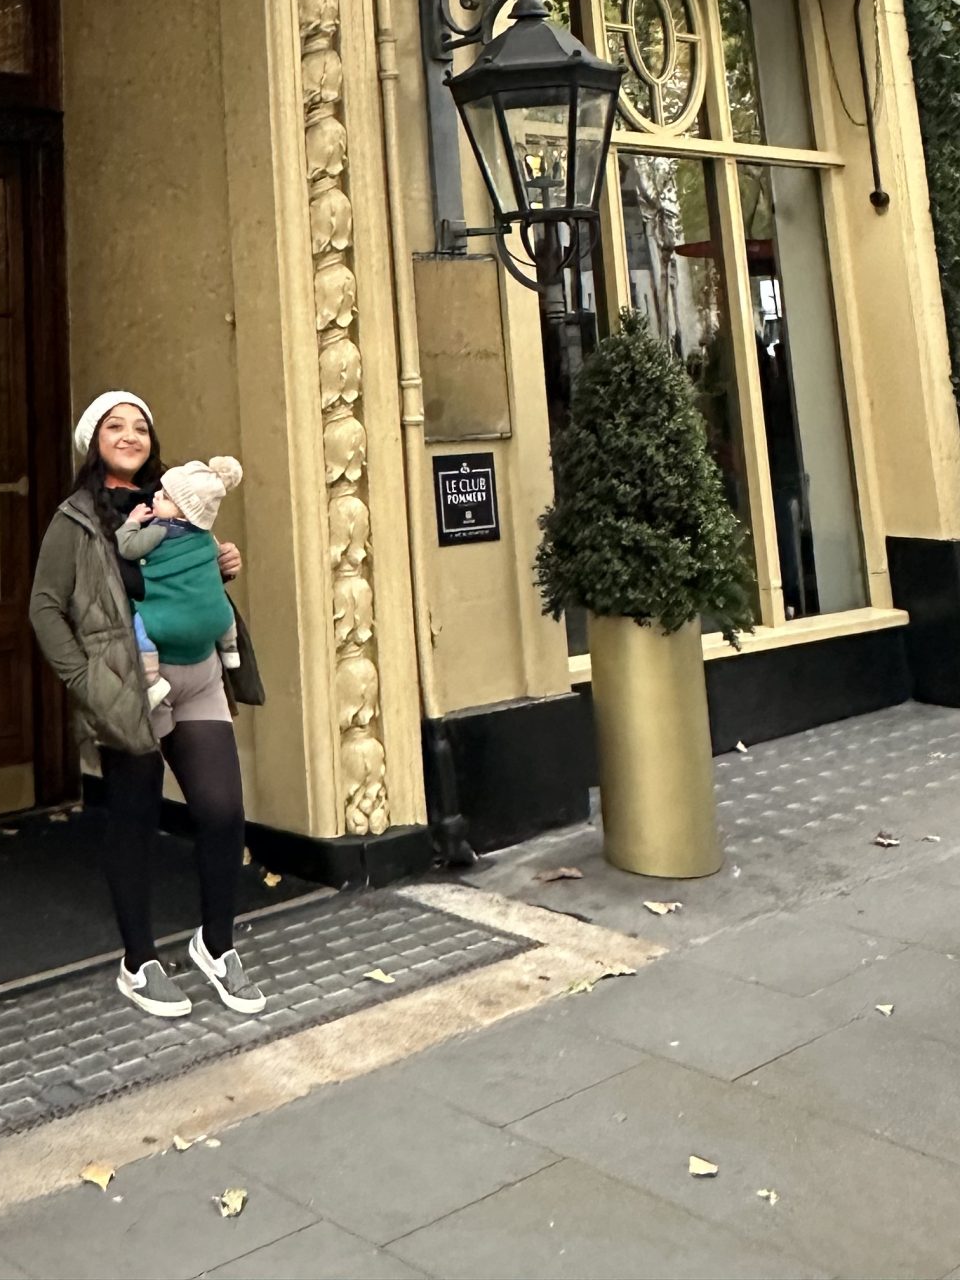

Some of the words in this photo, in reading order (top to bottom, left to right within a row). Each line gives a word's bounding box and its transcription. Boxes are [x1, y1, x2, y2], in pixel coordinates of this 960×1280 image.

[445, 480, 457, 493] LE
[459, 477, 486, 492] CLUB
[447, 492, 486, 504] POMMERY
